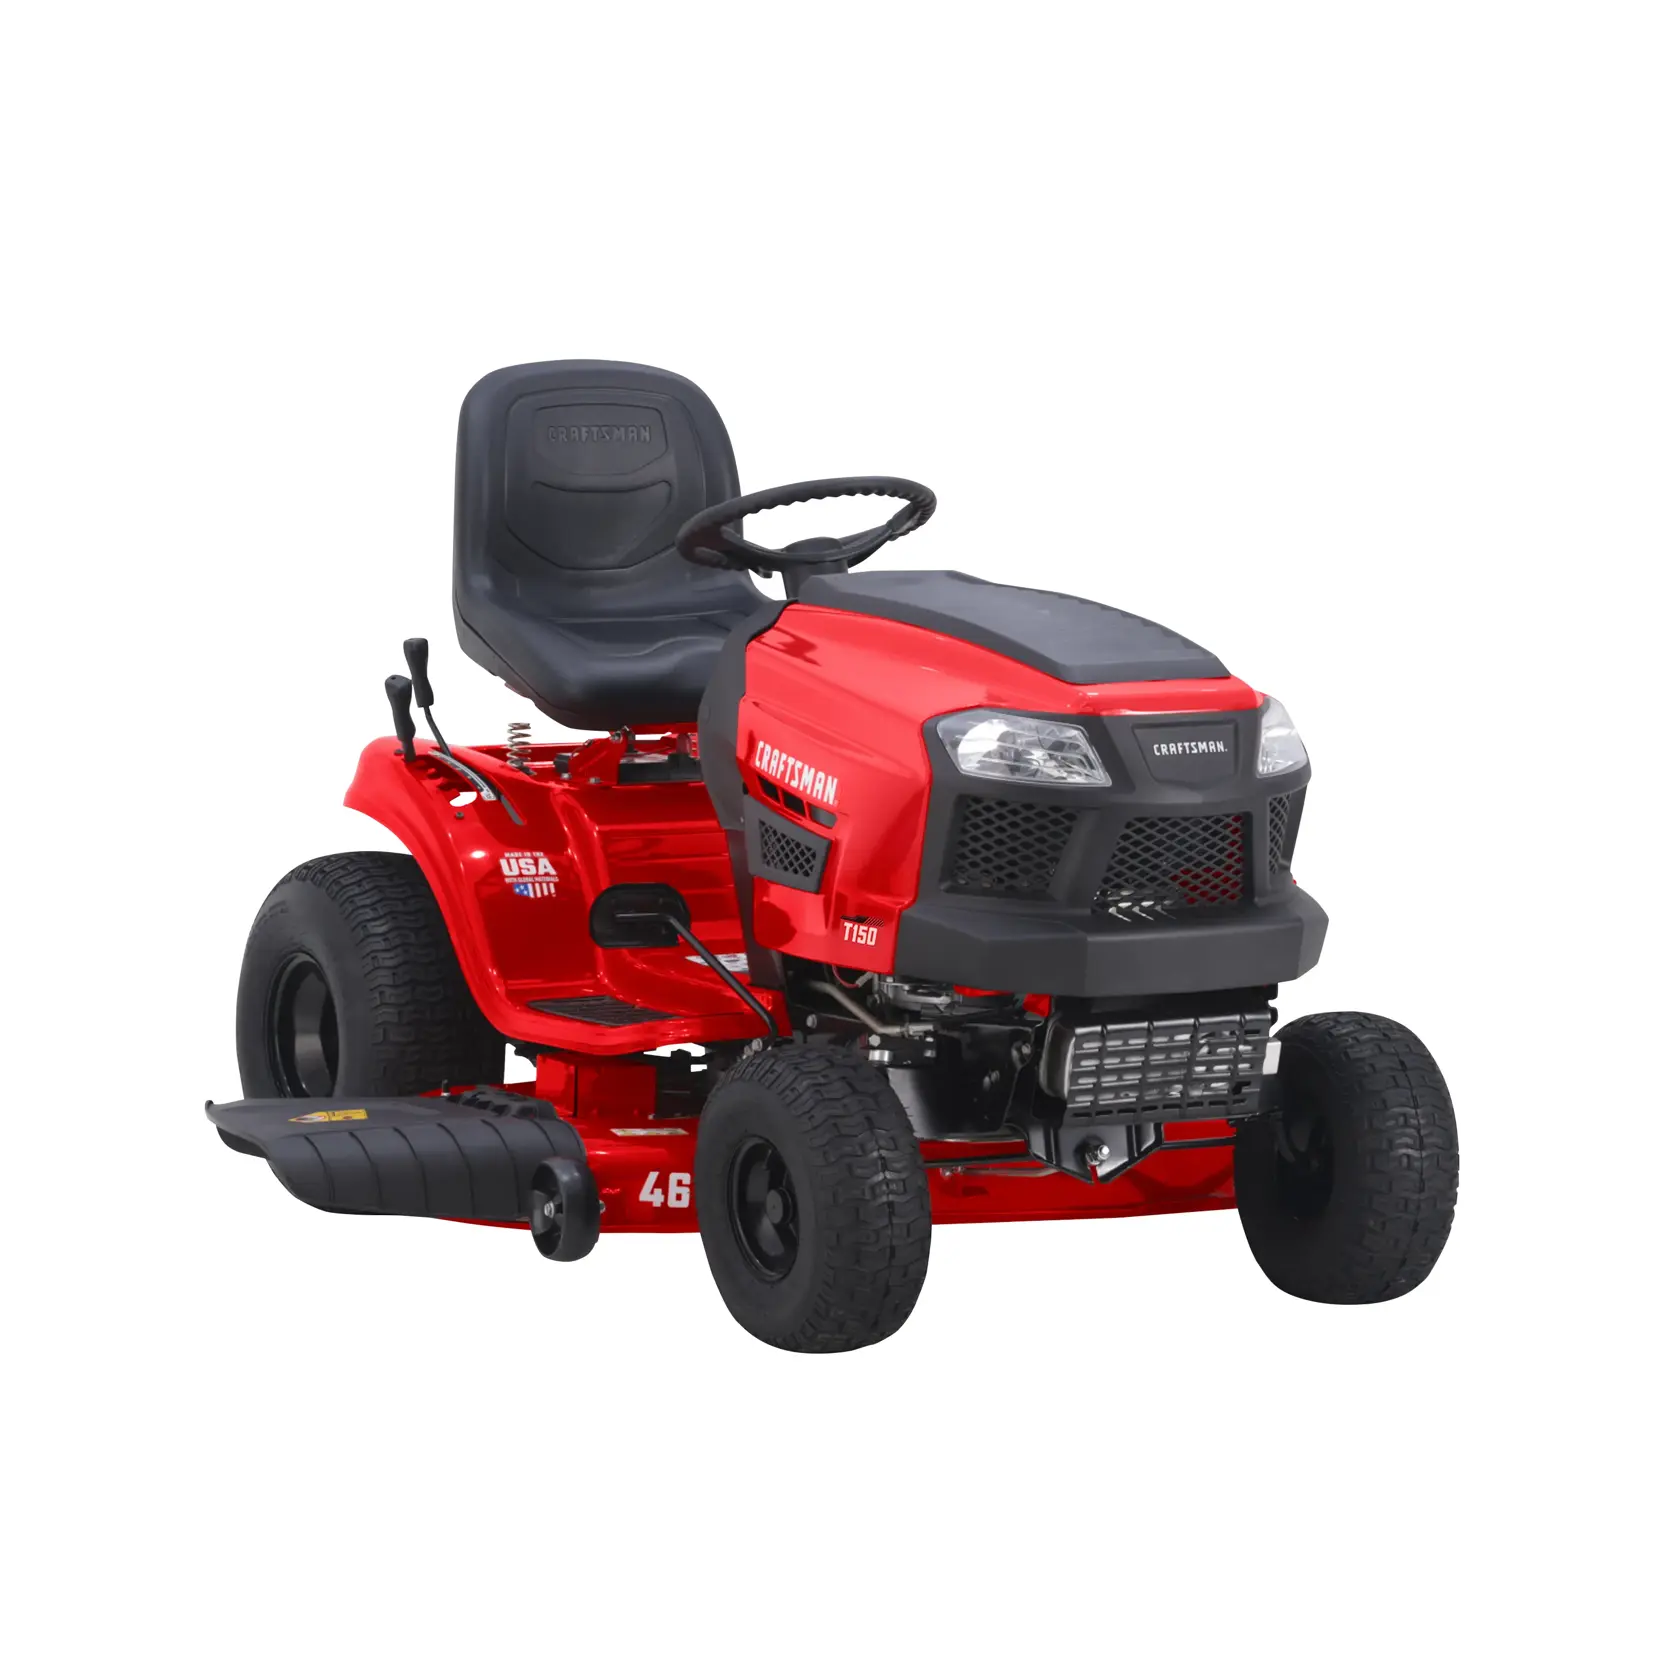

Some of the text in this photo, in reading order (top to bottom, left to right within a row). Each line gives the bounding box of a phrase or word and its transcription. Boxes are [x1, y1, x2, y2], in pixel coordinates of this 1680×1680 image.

[548, 425, 651, 442] CRAFTSMAN
[755, 740, 838, 806] CRAFTSMAN
[500, 858, 557, 876] USA
[843, 921, 878, 946] T150
[639, 1171, 691, 1208] 46
